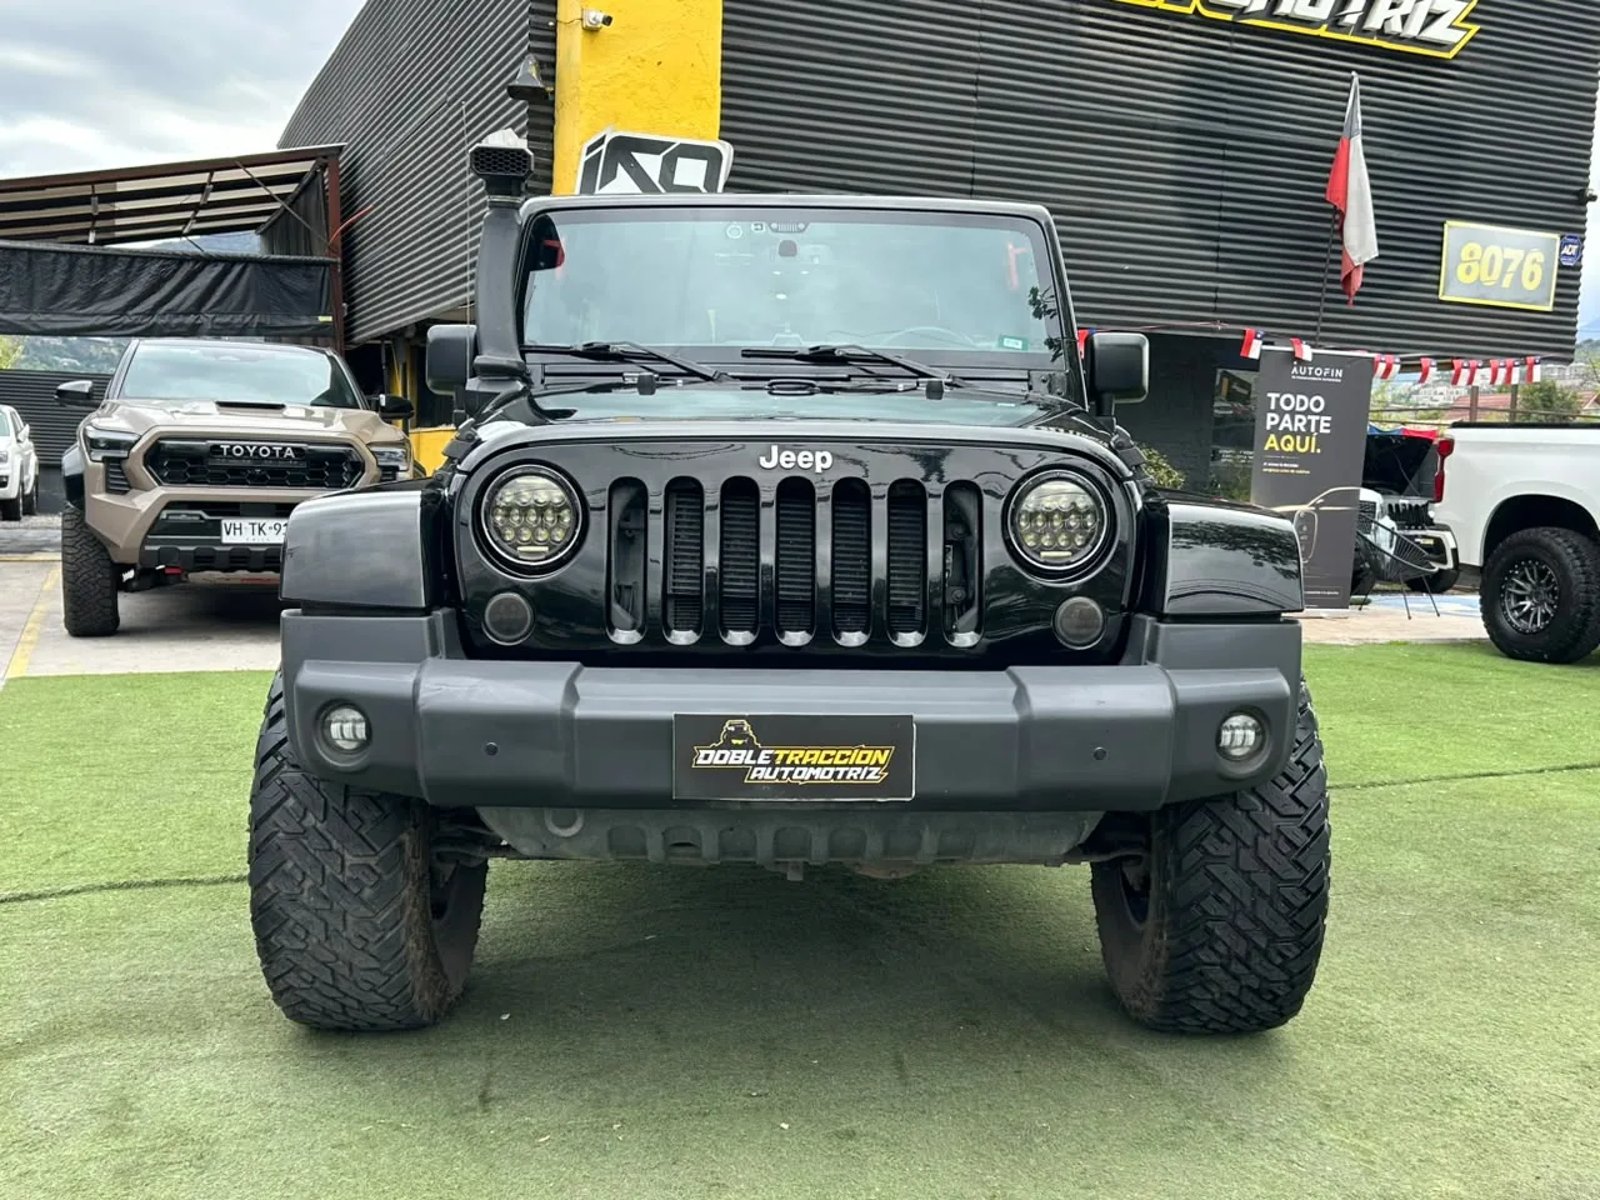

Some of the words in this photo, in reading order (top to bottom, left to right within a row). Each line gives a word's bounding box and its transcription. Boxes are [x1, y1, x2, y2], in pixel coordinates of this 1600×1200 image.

[1456, 241, 1545, 291] 8076
[1291, 361, 1344, 378] AUTOFIN
[1266, 392, 1325, 413] TODO
[1265, 412, 1333, 434] PARTE
[220, 444, 296, 459] TOYOTA
[1263, 432, 1321, 454] AQUÍ.
[759, 444, 834, 474] Jeep
[749, 766, 882, 781] AUTOMOTRIZ
